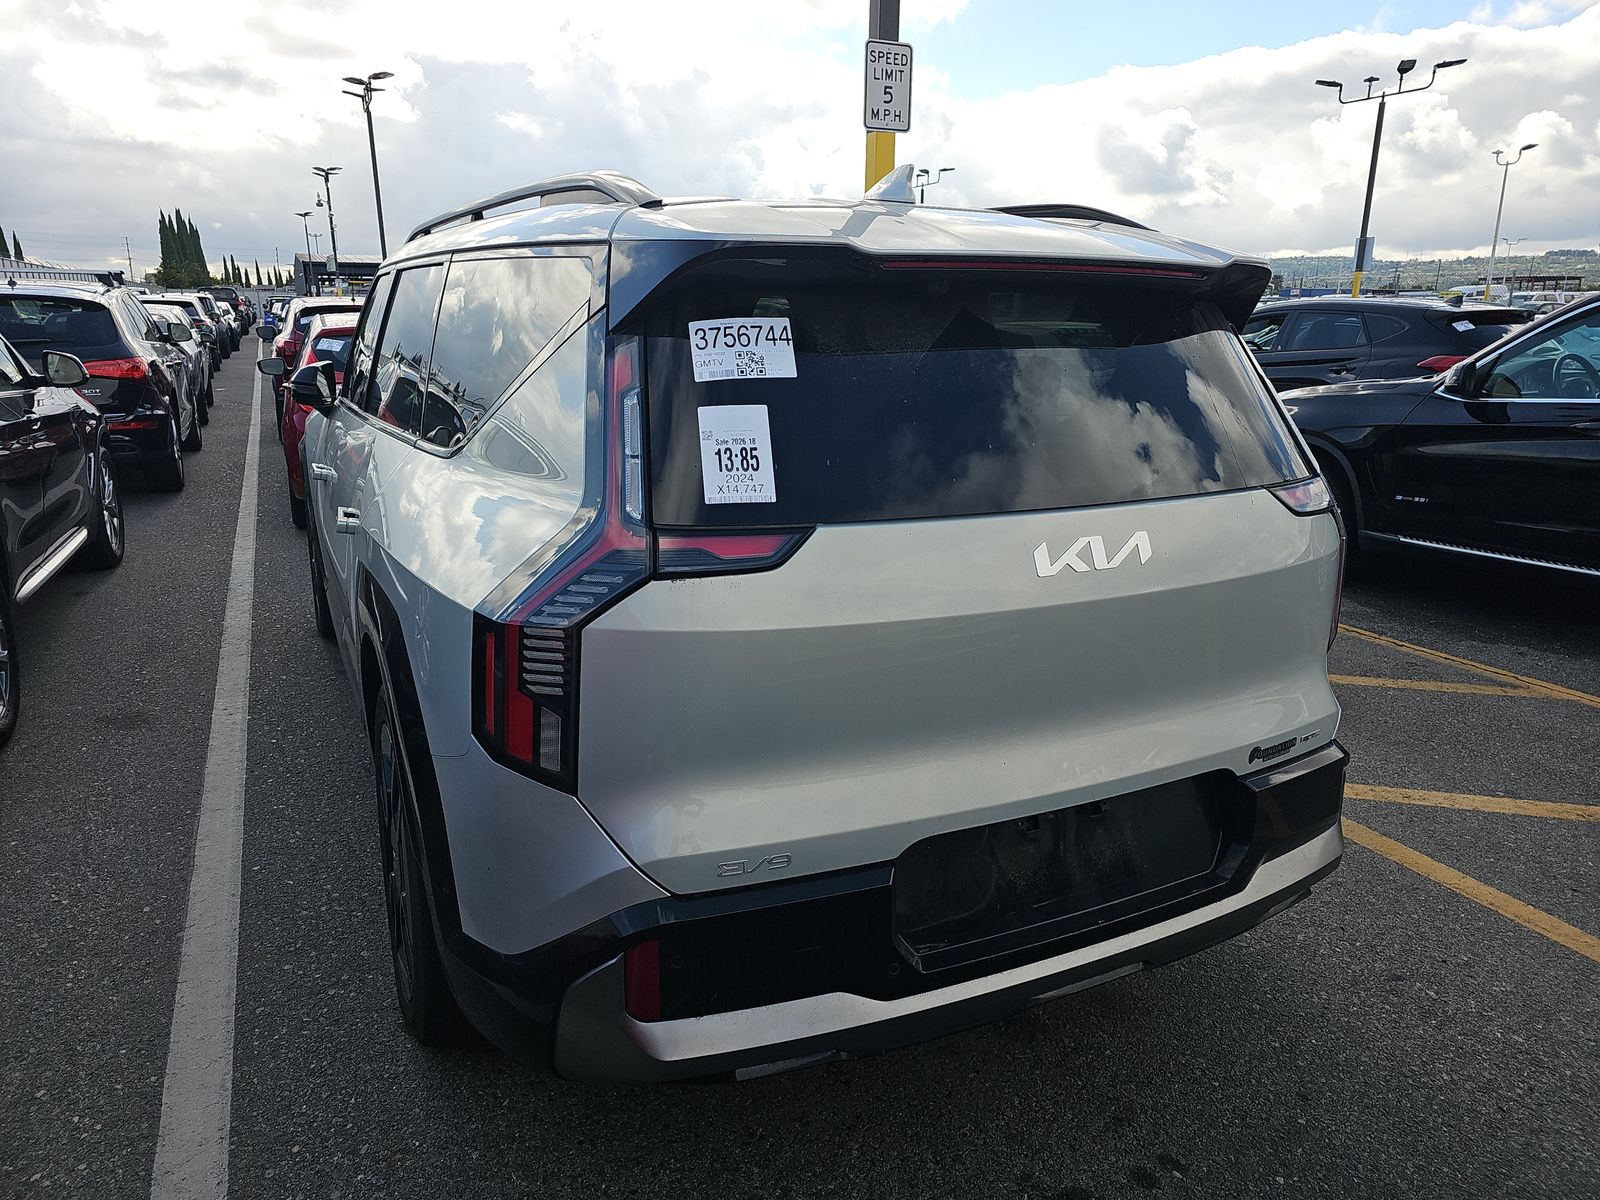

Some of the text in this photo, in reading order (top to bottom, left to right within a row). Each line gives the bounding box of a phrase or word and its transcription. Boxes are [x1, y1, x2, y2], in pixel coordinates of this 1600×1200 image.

[869, 49, 908, 67] SPEED
[873, 66, 905, 83] LIMIT
[883, 85, 894, 104] 5
[871, 107, 905, 123] M.P.H.
[694, 324, 792, 351] 3756744
[694, 358, 724, 369] GMTV
[715, 438, 730, 446] Sale
[749, 437, 757, 446] 18
[714, 446, 760, 473] 13:85
[725, 473, 754, 484] 2024
[717, 483, 765, 495] X14,747
[1033, 530, 1152, 578] KIA
[717, 852, 792, 877] EV9
